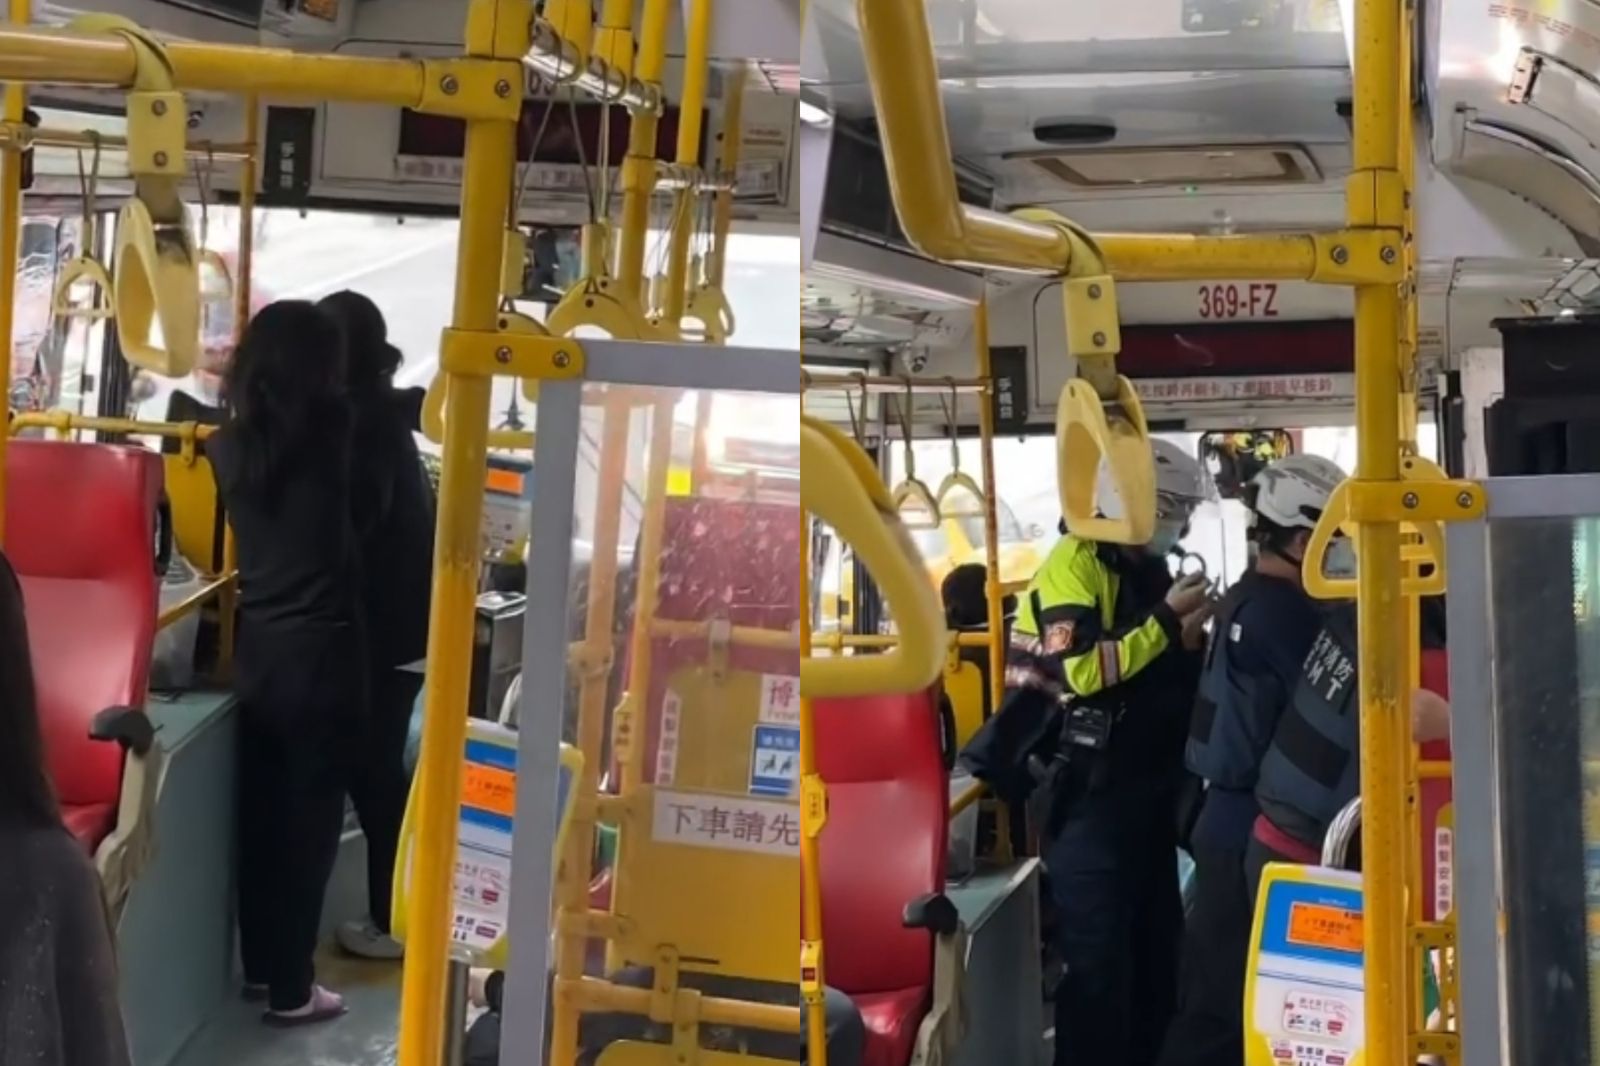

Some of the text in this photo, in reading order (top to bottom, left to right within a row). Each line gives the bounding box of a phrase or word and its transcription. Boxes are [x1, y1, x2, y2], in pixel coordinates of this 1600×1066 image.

[1198, 283, 1278, 318] 369-FZ
[667, 803, 799, 847] 下車請先
